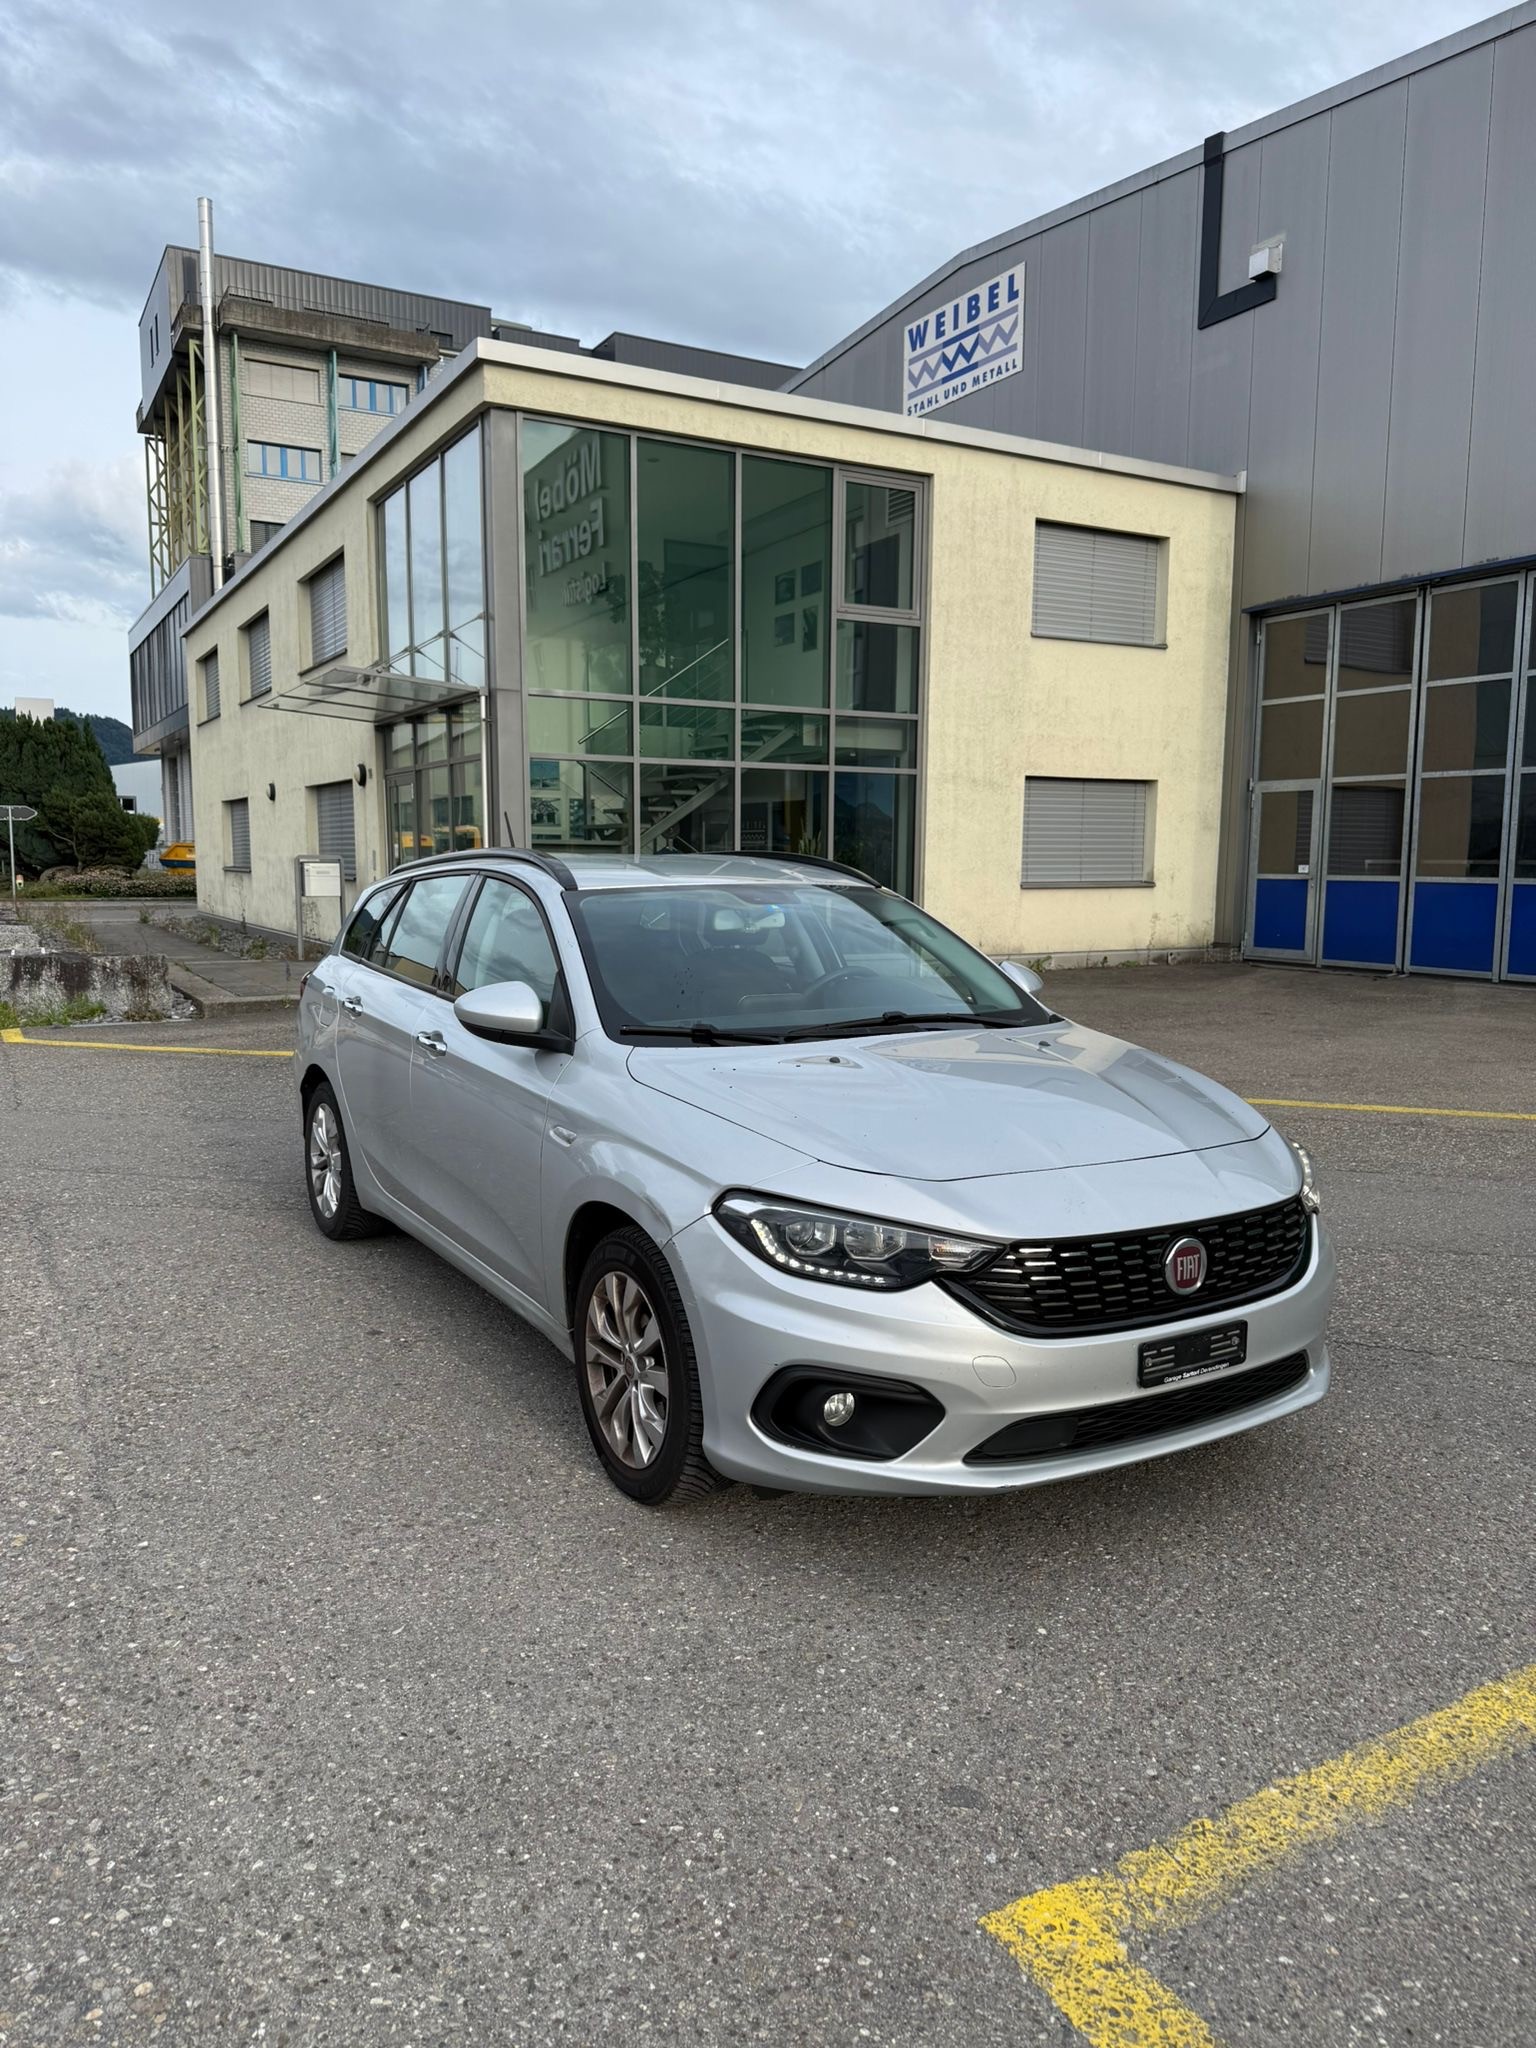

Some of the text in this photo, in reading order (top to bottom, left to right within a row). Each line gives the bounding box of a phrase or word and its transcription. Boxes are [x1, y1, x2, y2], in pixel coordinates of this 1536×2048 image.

[907, 273, 1020, 352] WEIBEL
[907, 358, 1018, 417] STAHL UND METALL
[1177, 1254, 1200, 1281] FIAT
